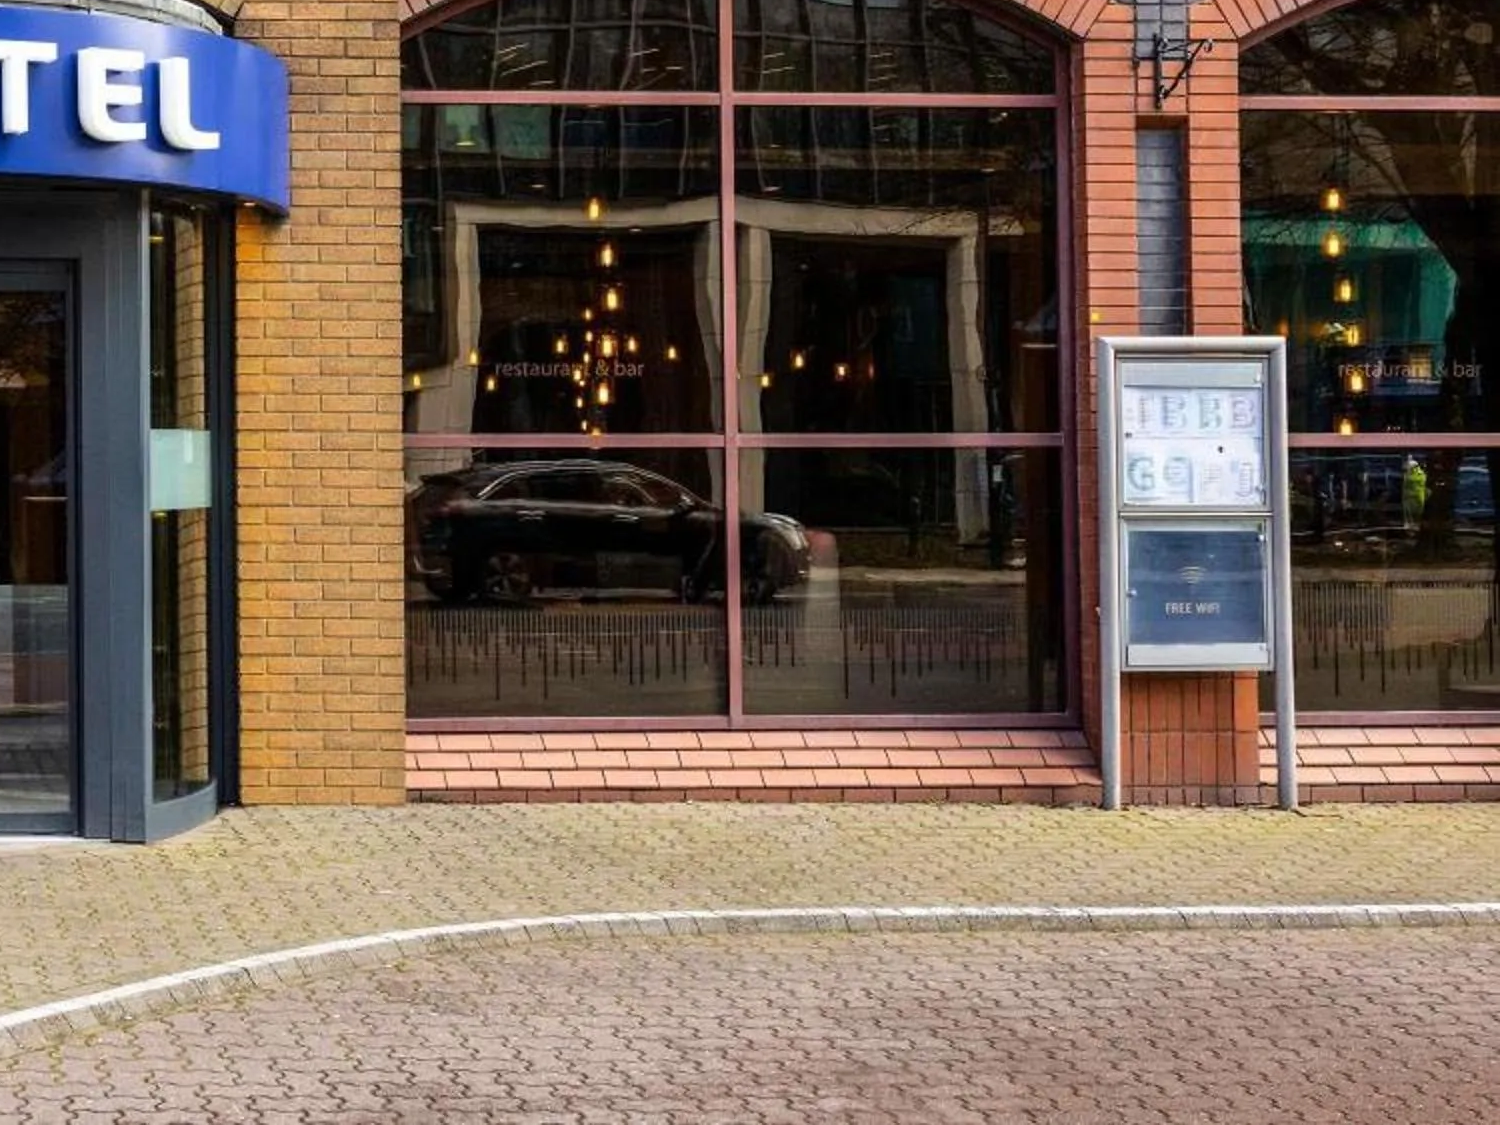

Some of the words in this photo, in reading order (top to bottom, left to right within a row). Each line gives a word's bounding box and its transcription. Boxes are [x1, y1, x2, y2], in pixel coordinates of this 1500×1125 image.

[595, 358, 609, 377] &
[614, 359, 645, 377] bar
[1453, 359, 1483, 378] bar
[1165, 602, 1192, 615] FREE
